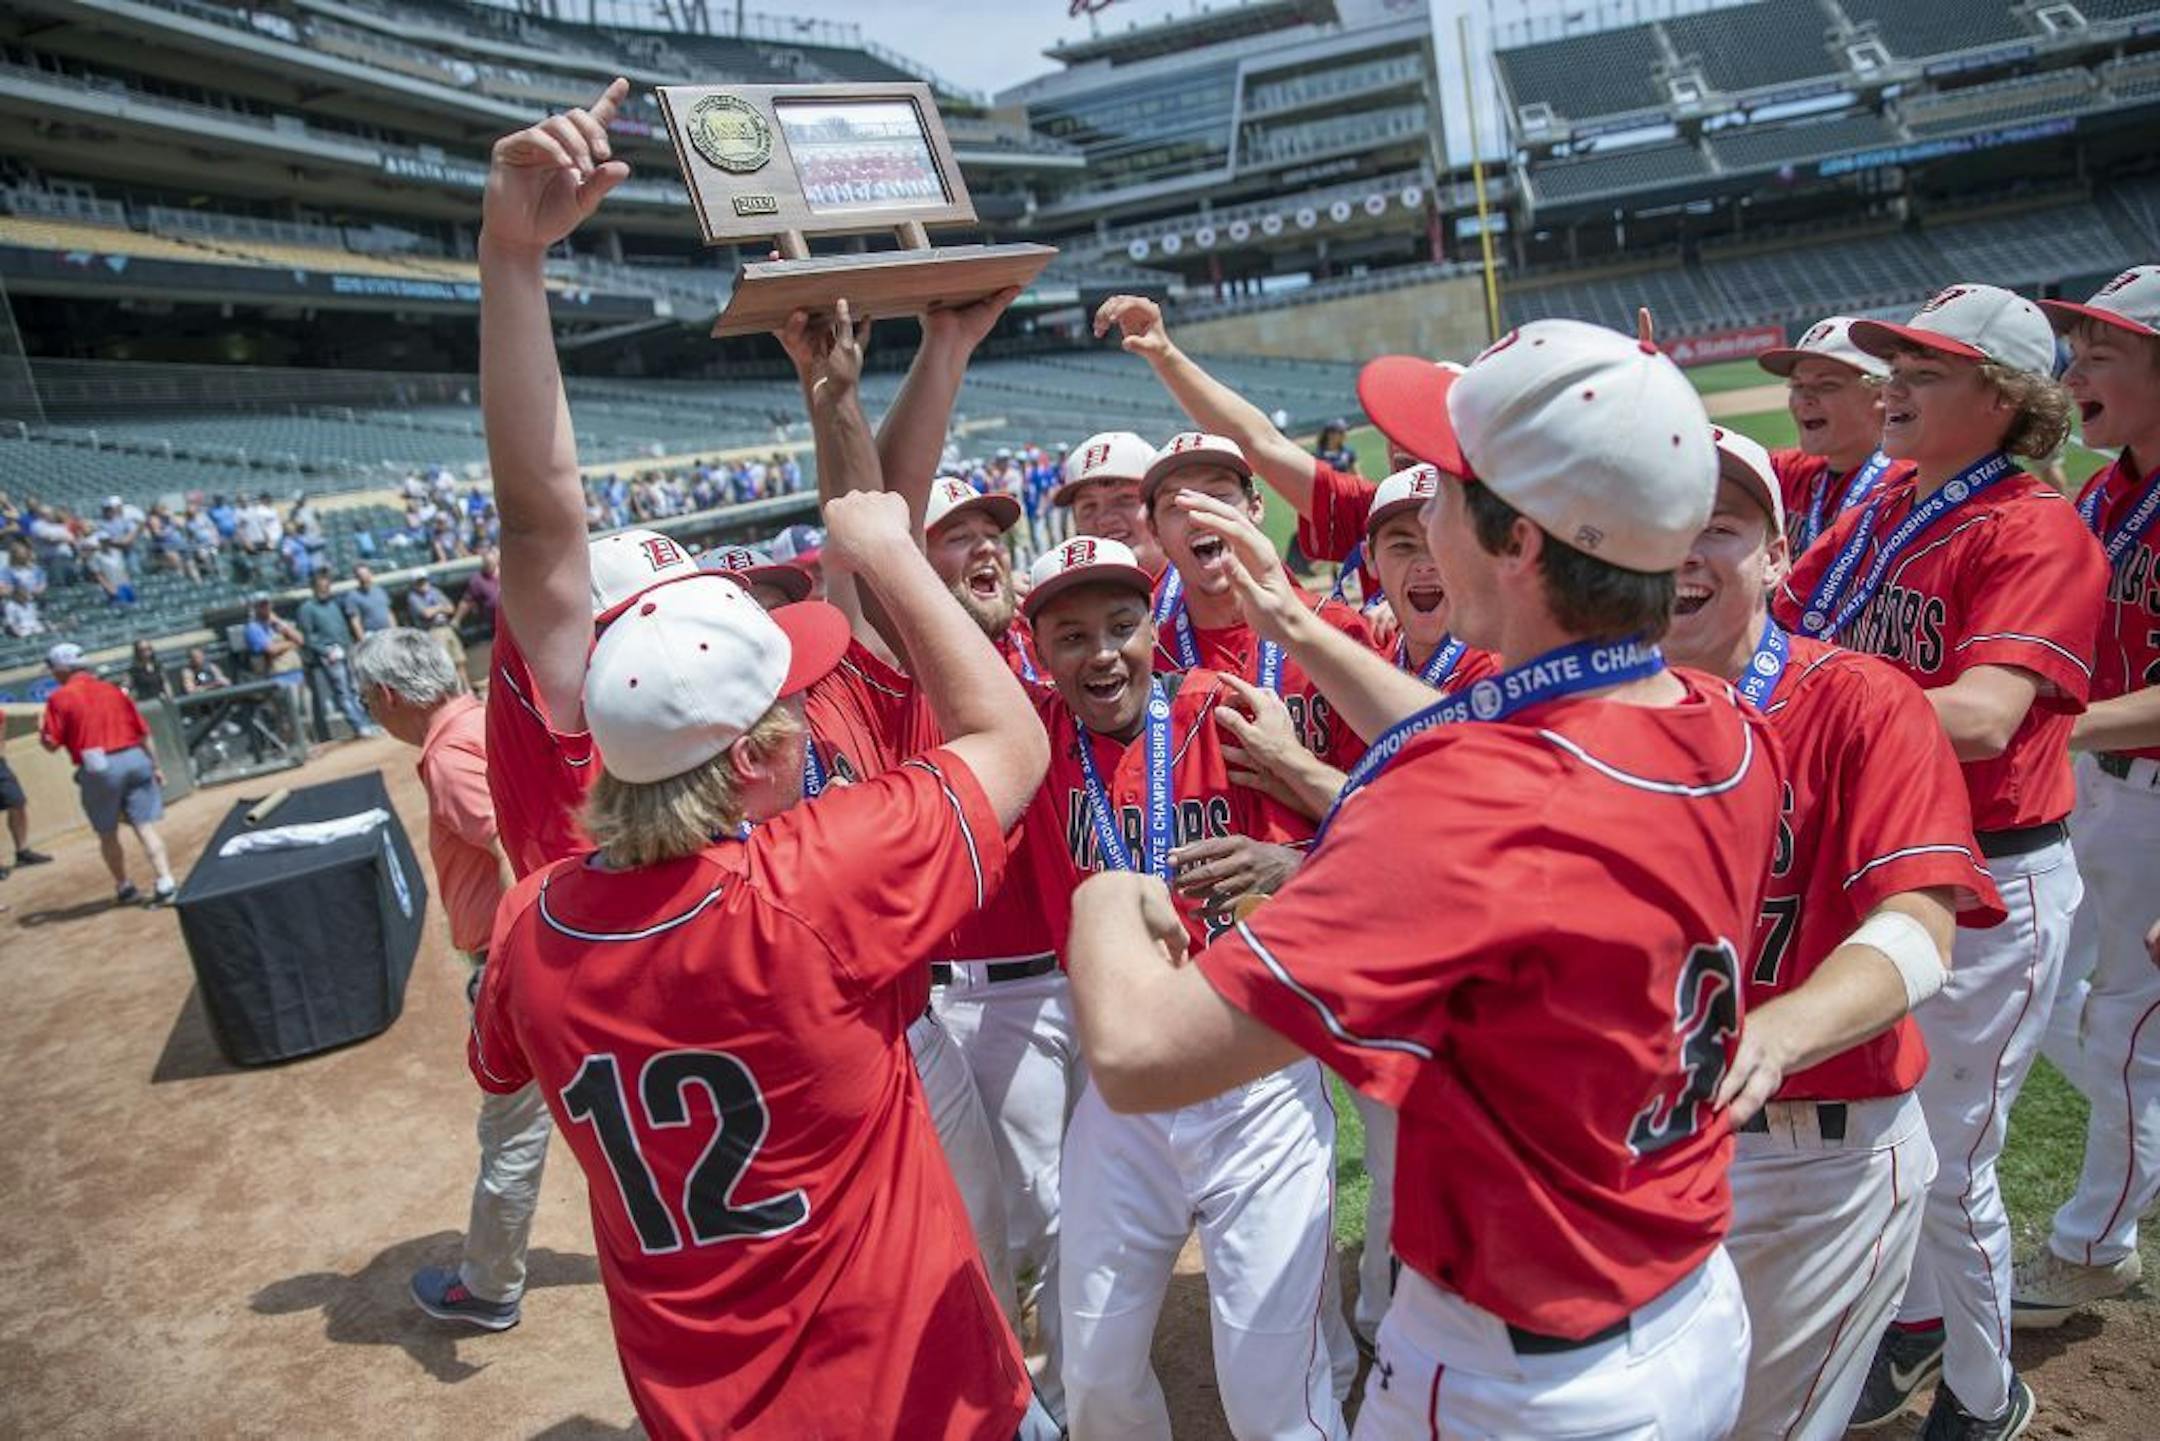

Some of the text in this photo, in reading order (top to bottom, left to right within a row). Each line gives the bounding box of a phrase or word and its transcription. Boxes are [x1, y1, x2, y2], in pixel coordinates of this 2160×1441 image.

[1967, 455, 2008, 486] STATE
[1865, 499, 1944, 590] CHAMPIONSHIPS
[1504, 654, 1583, 700] STATE
[1153, 722, 1167, 831] CHAMPIONSHIPS
[1752, 894, 1800, 986] 7
[560, 1050, 811, 1255] 12
